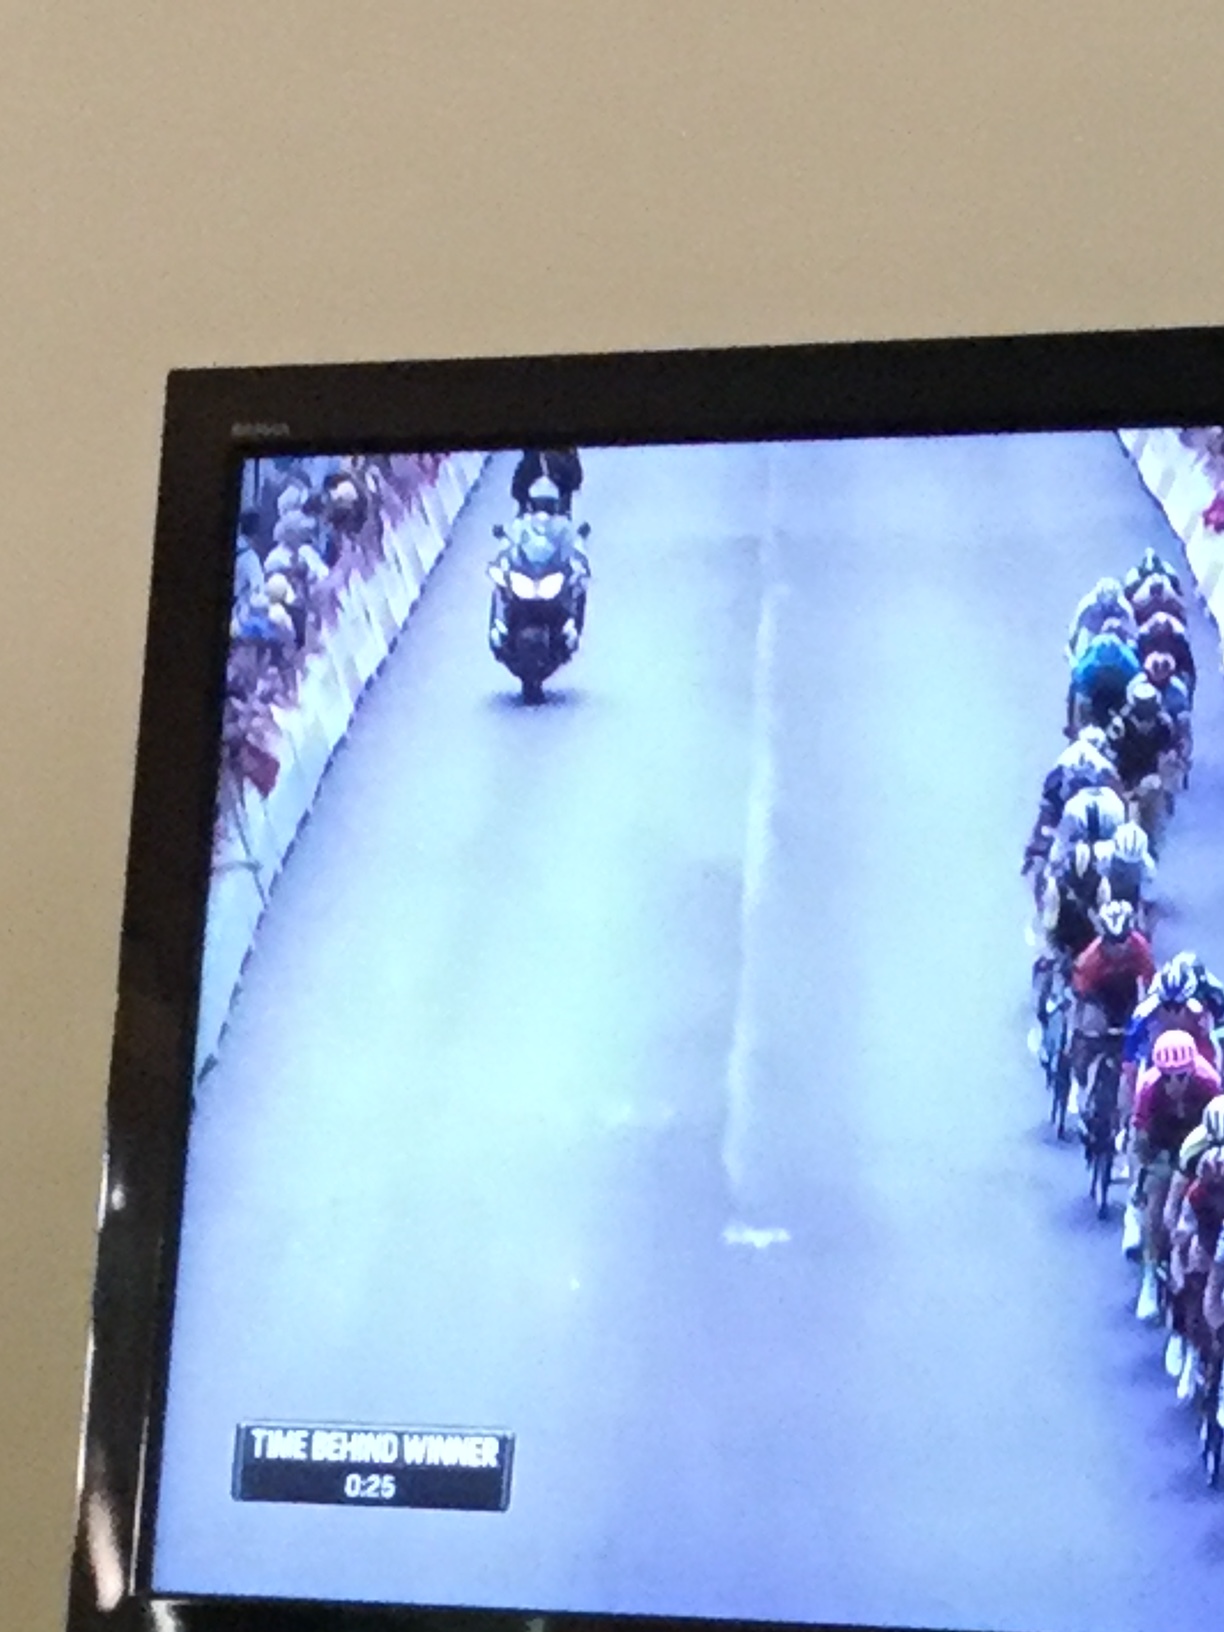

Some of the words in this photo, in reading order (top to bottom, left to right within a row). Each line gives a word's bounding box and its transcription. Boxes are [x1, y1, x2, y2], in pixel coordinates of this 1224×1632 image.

[252, 1429, 308, 1459] TIME
[311, 1432, 398, 1463] BEHIND
[403, 1434, 500, 1467] WINNER
[344, 1473, 396, 1499] 0:25
